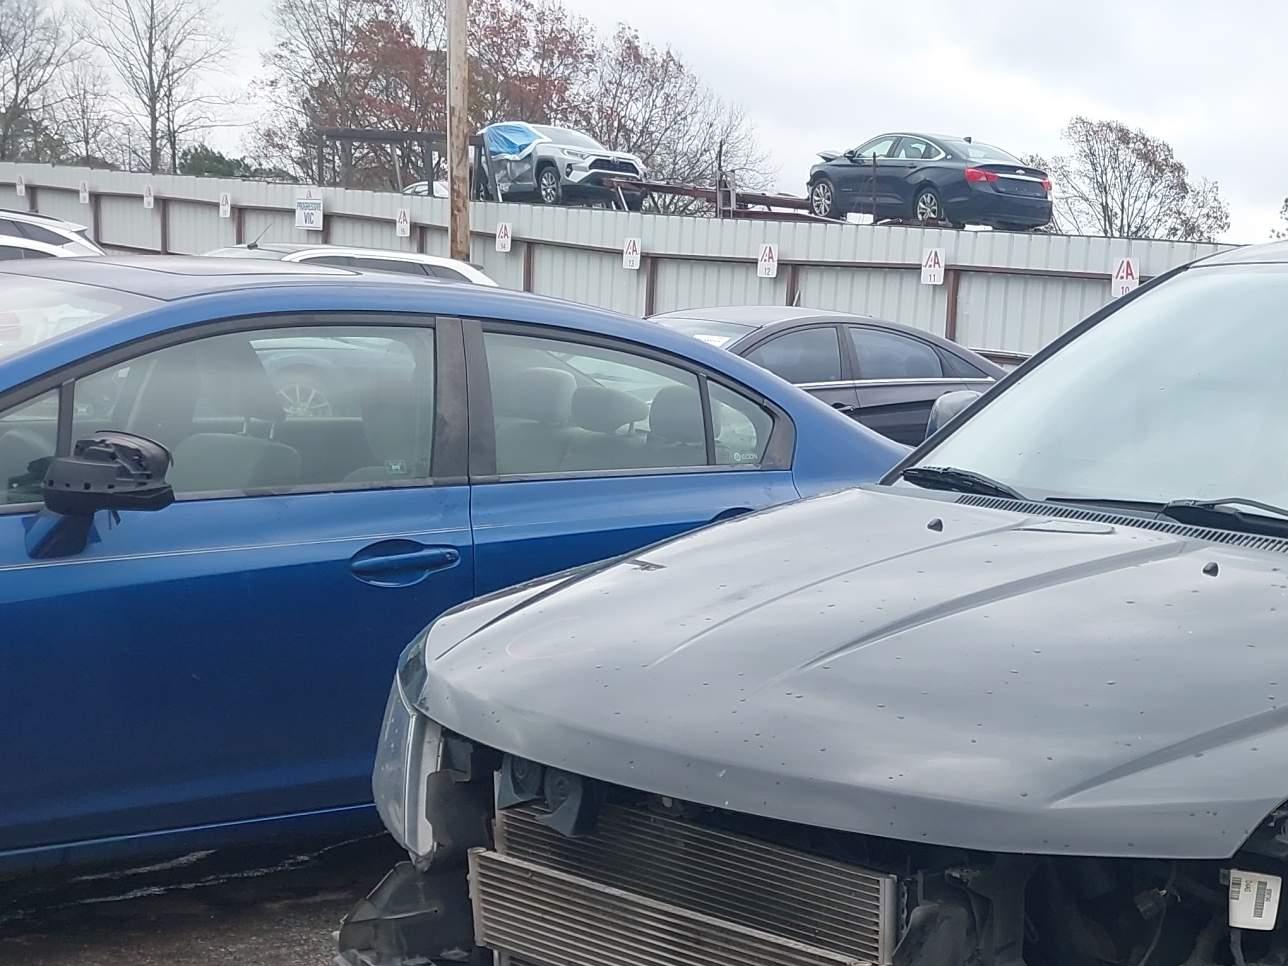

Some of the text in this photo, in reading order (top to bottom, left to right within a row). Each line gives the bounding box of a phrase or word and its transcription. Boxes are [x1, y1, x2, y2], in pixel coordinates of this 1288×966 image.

[304, 212, 315, 225] VIC
[764, 267, 771, 276] 12
[929, 274, 936, 282] 11
